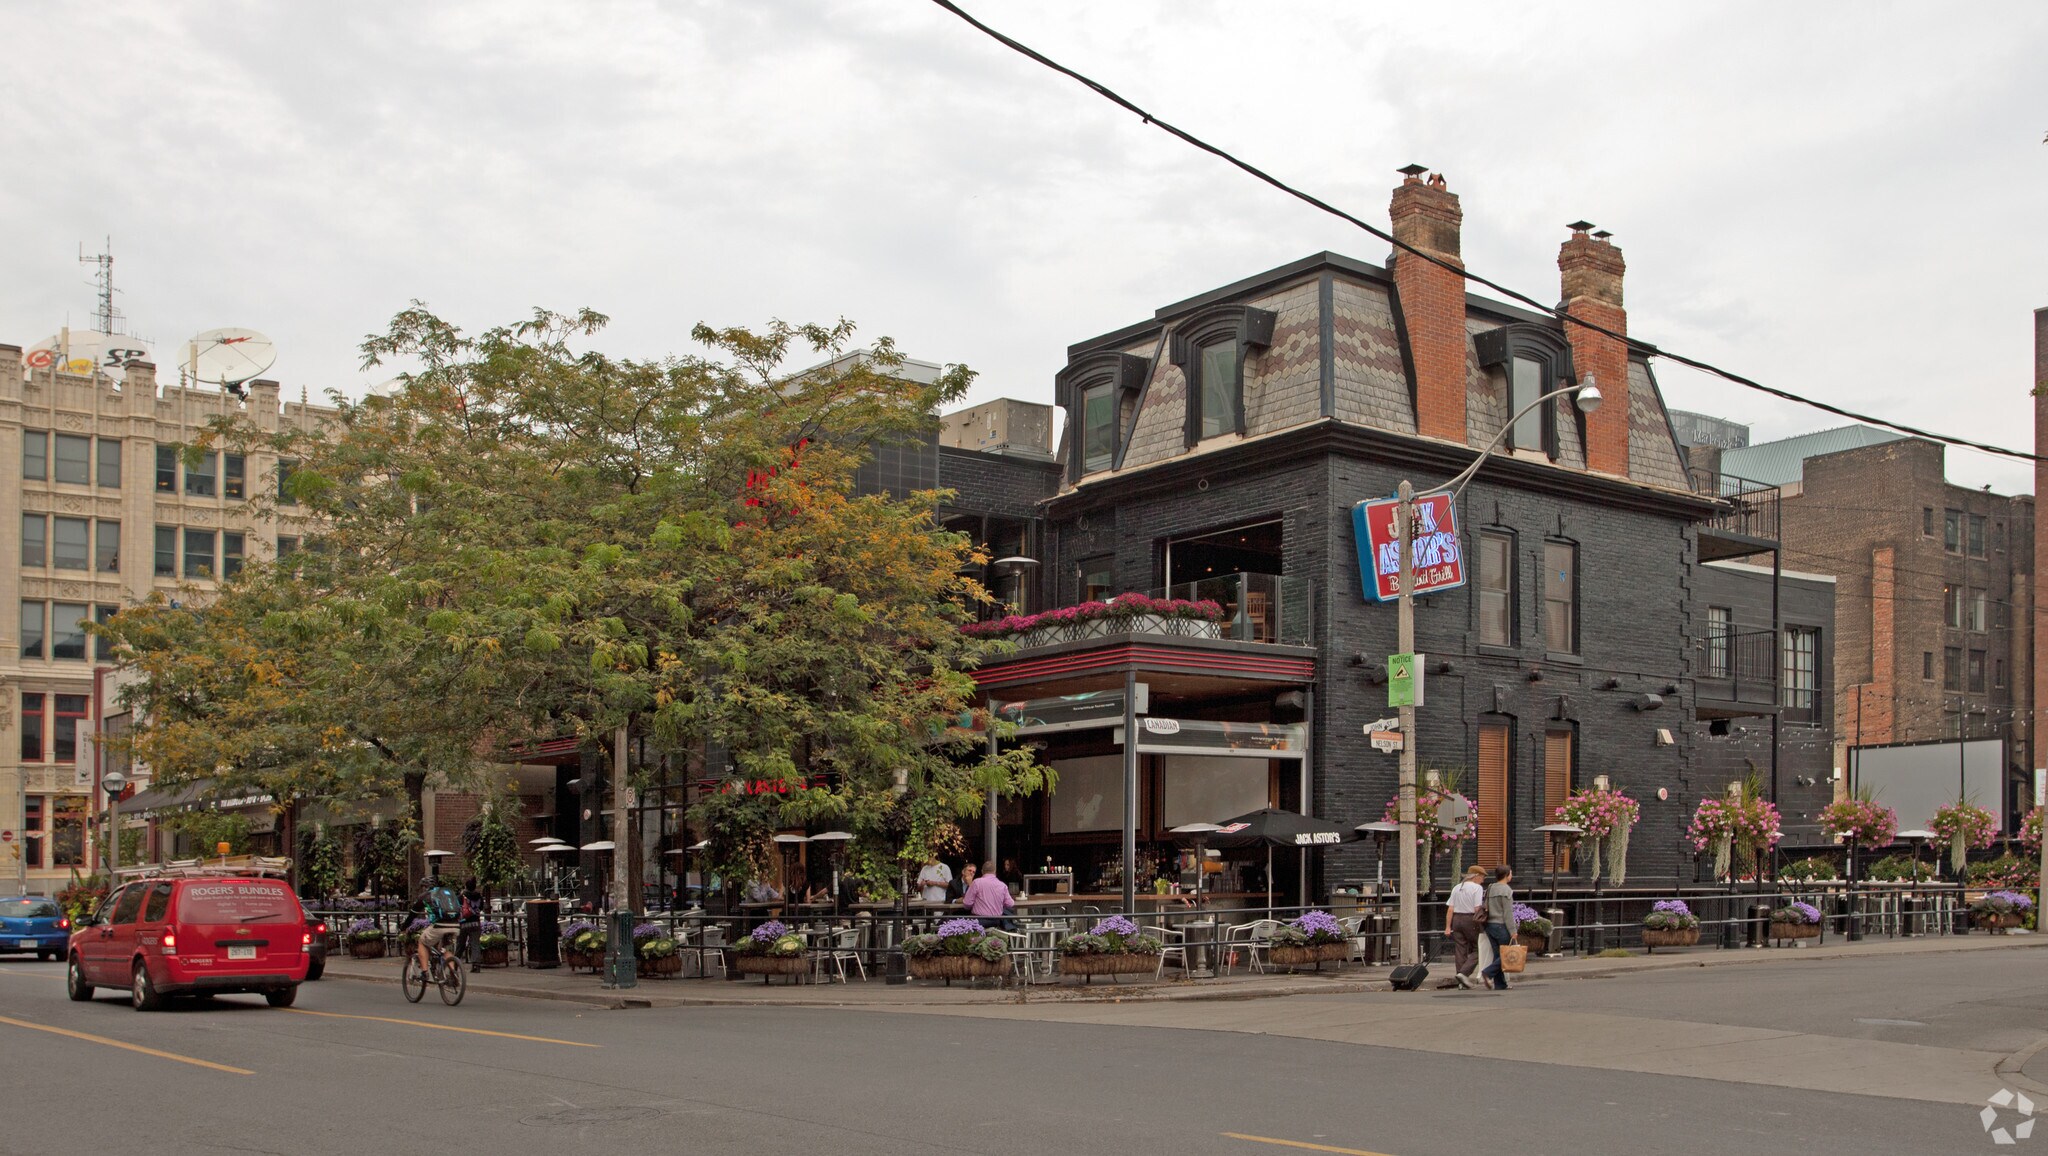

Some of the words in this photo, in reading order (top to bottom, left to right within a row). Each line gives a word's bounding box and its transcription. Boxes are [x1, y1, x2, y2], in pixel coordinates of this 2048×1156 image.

[1379, 531, 1458, 576] ASOR'S
[1392, 655, 1412, 665] NOTICE
[1146, 718, 1178, 731] CANADIAN
[1370, 723, 1383, 731] JOHN
[1387, 720, 1393, 728] ST
[1375, 740, 1392, 748] NELSON
[1392, 741, 1398, 749] ST
[1295, 832, 1314, 845] JACK
[1313, 831, 1341, 845] ASTOR'S
[190, 886, 235, 896] ROGERS
[238, 886, 284, 896] BUNDLES
